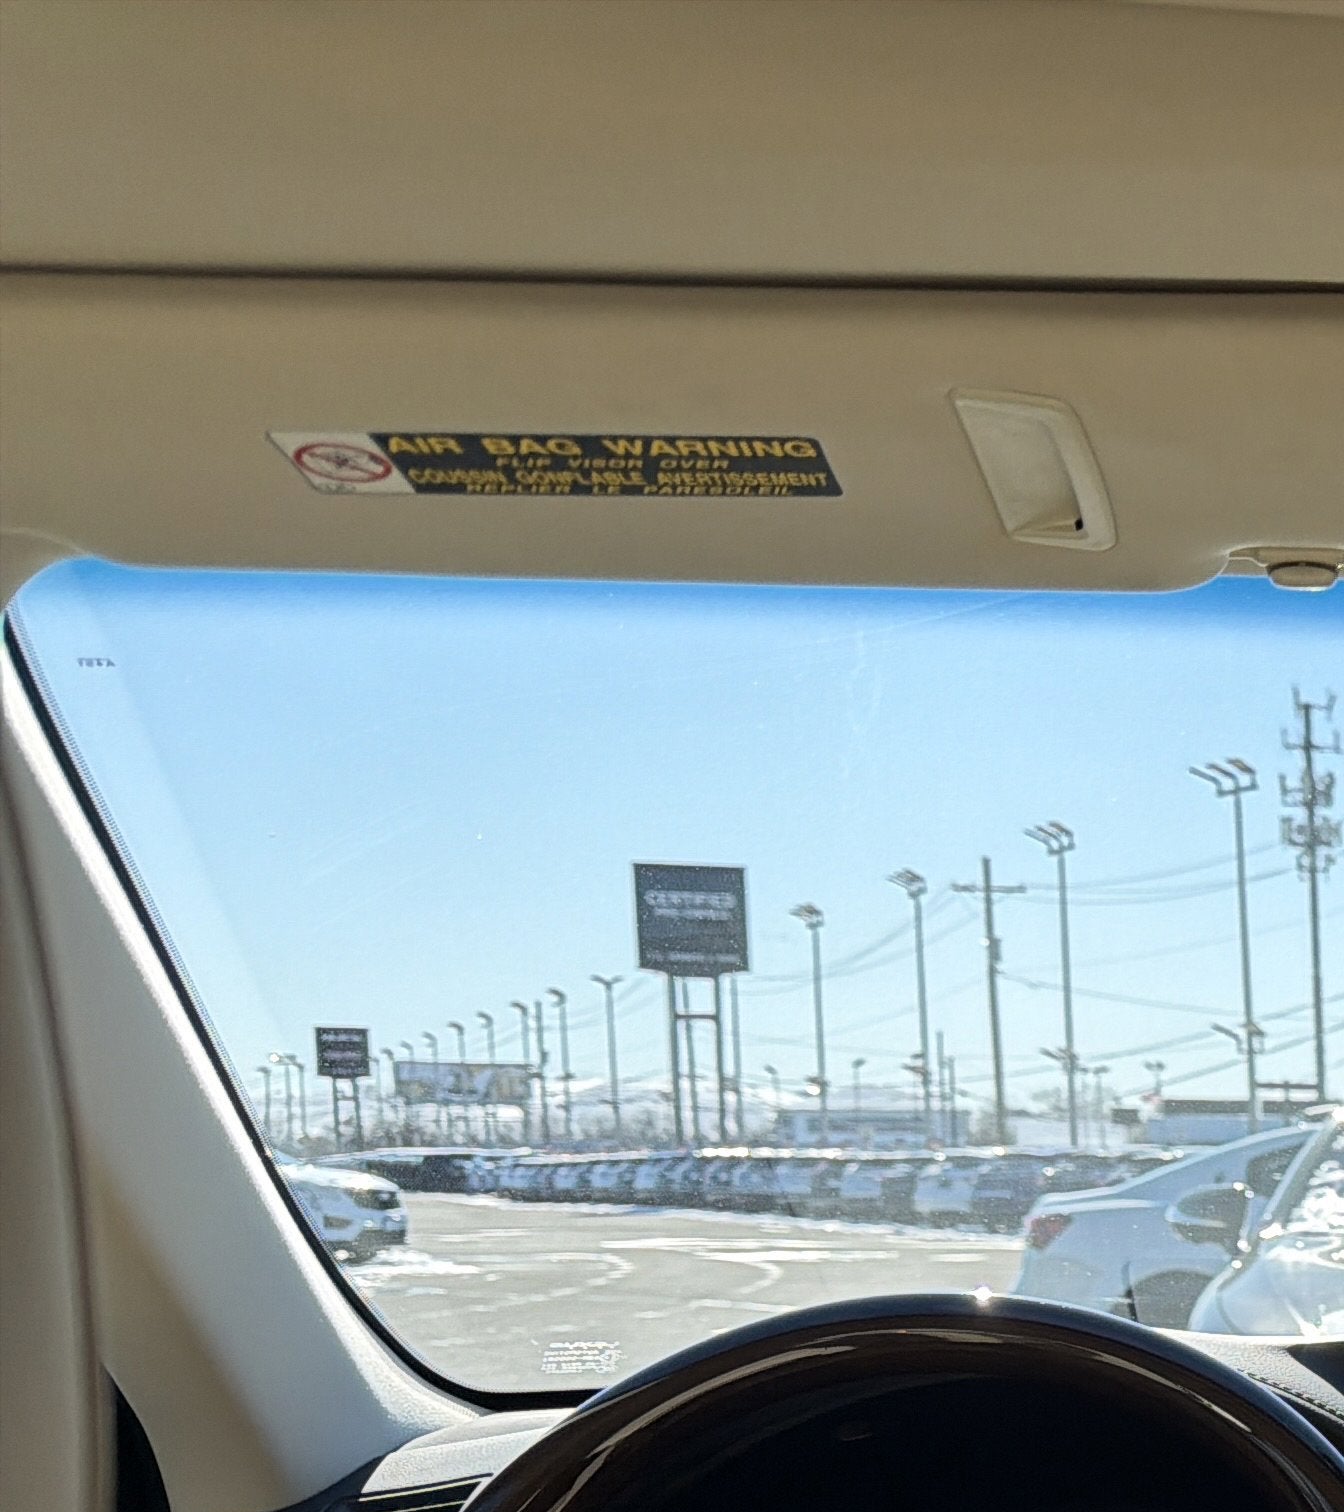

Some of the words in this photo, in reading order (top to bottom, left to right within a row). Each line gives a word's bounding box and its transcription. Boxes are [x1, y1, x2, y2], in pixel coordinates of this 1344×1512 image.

[388, 437, 464, 454] AIR
[481, 437, 582, 456] BAG
[603, 439, 817, 458] WARNING
[568, 458, 643, 469] VISOR
[660, 459, 730, 470] OVER
[657, 472, 827, 487] AVERTISSEMENT
